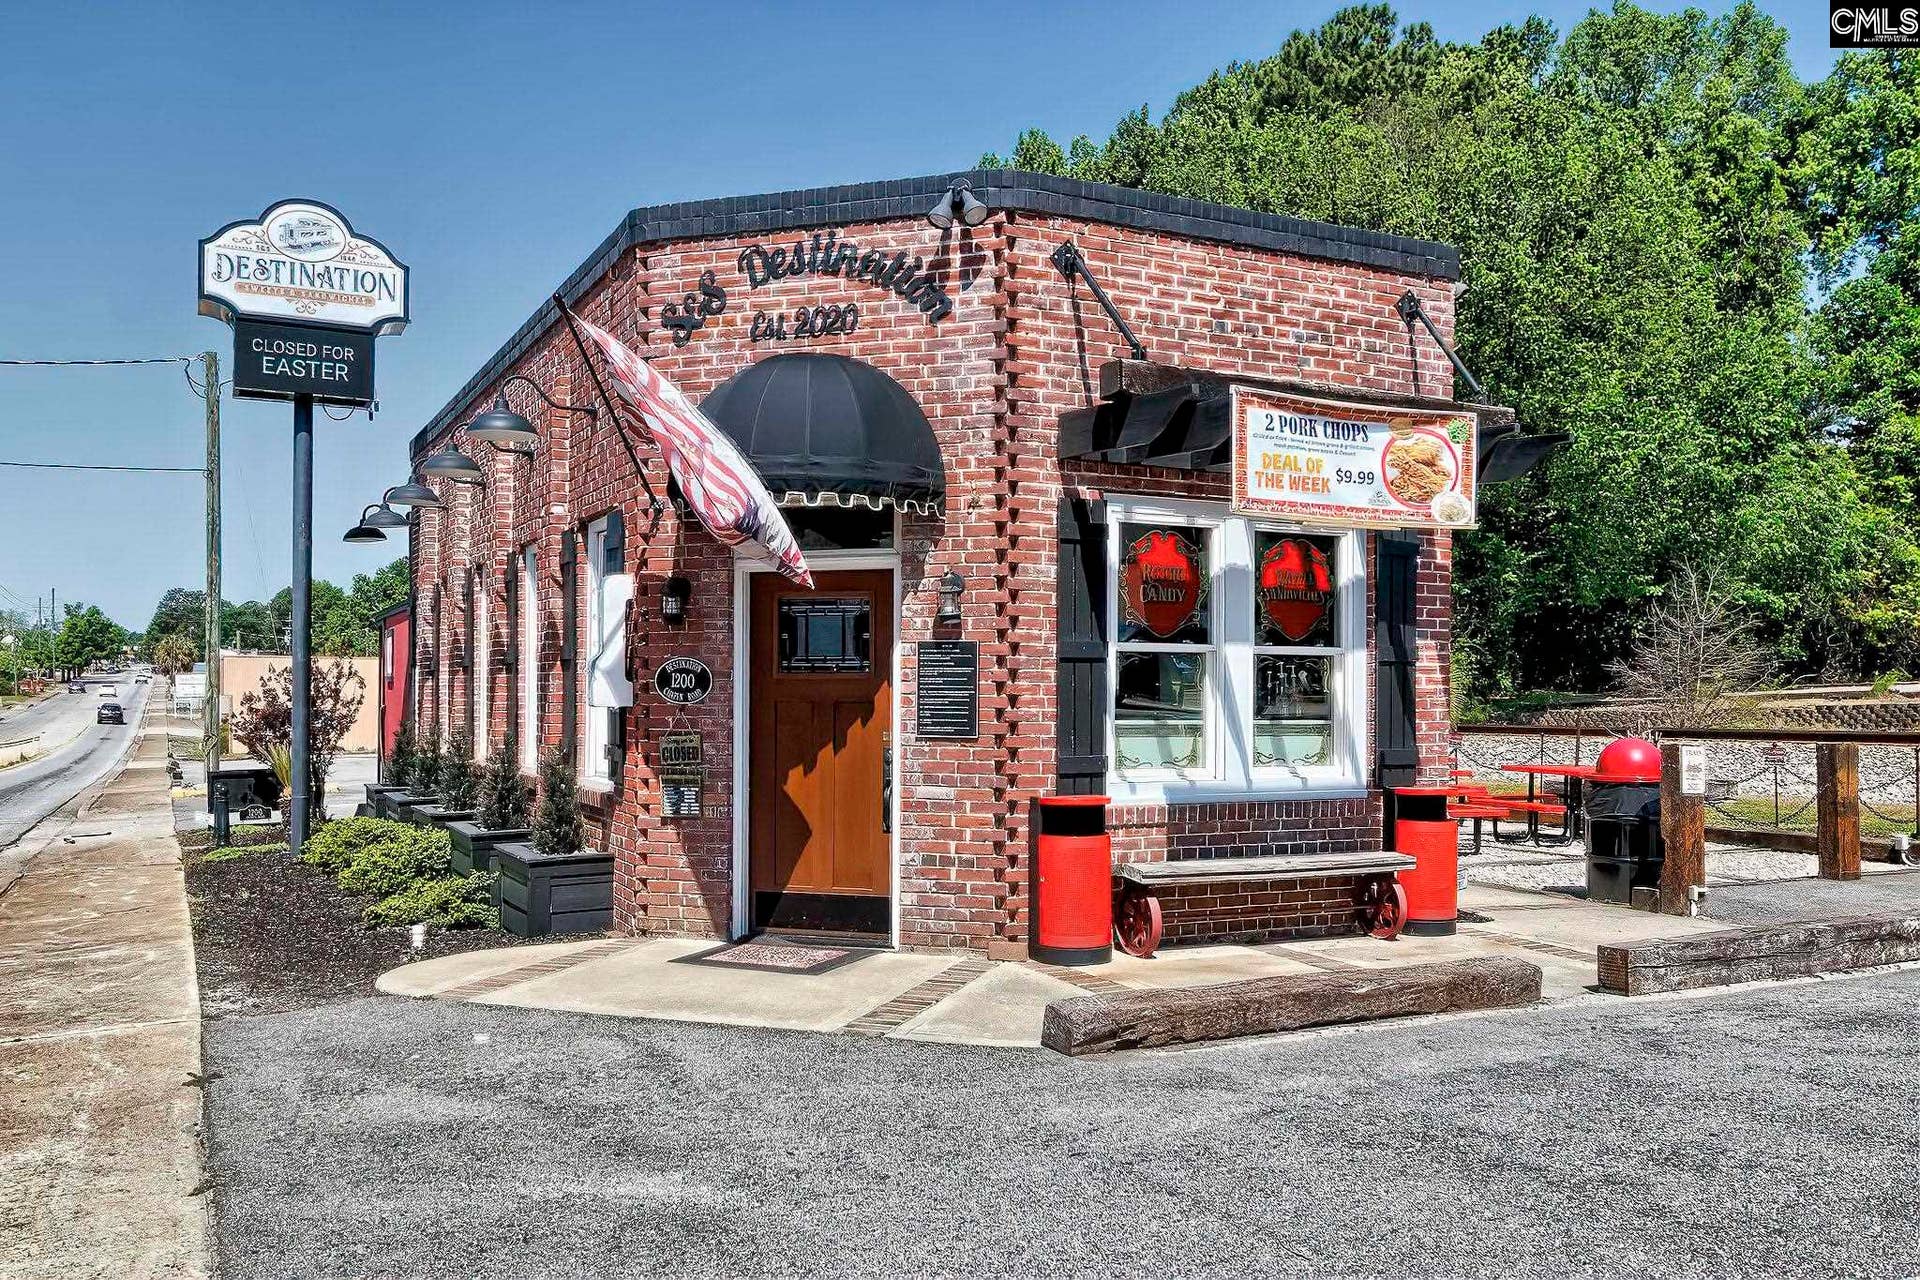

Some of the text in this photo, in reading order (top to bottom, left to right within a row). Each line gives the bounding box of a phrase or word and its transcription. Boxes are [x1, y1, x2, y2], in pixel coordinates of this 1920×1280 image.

[212, 253, 396, 302] DESTINATION
[738, 230, 953, 327] Destination
[794, 303, 859, 339] 2020
[252, 338, 355, 361] CLOSED FOR
[262, 357, 349, 381] EASTER
[1265, 413, 1369, 443] 2 PORK CHOPS
[1261, 451, 1324, 474] DEAL OF
[1255, 471, 1331, 494] THE WEEK
[1336, 467, 1375, 486] $9.99
[671, 672, 695, 688] 1200
[661, 745, 700, 761] CLOSED
